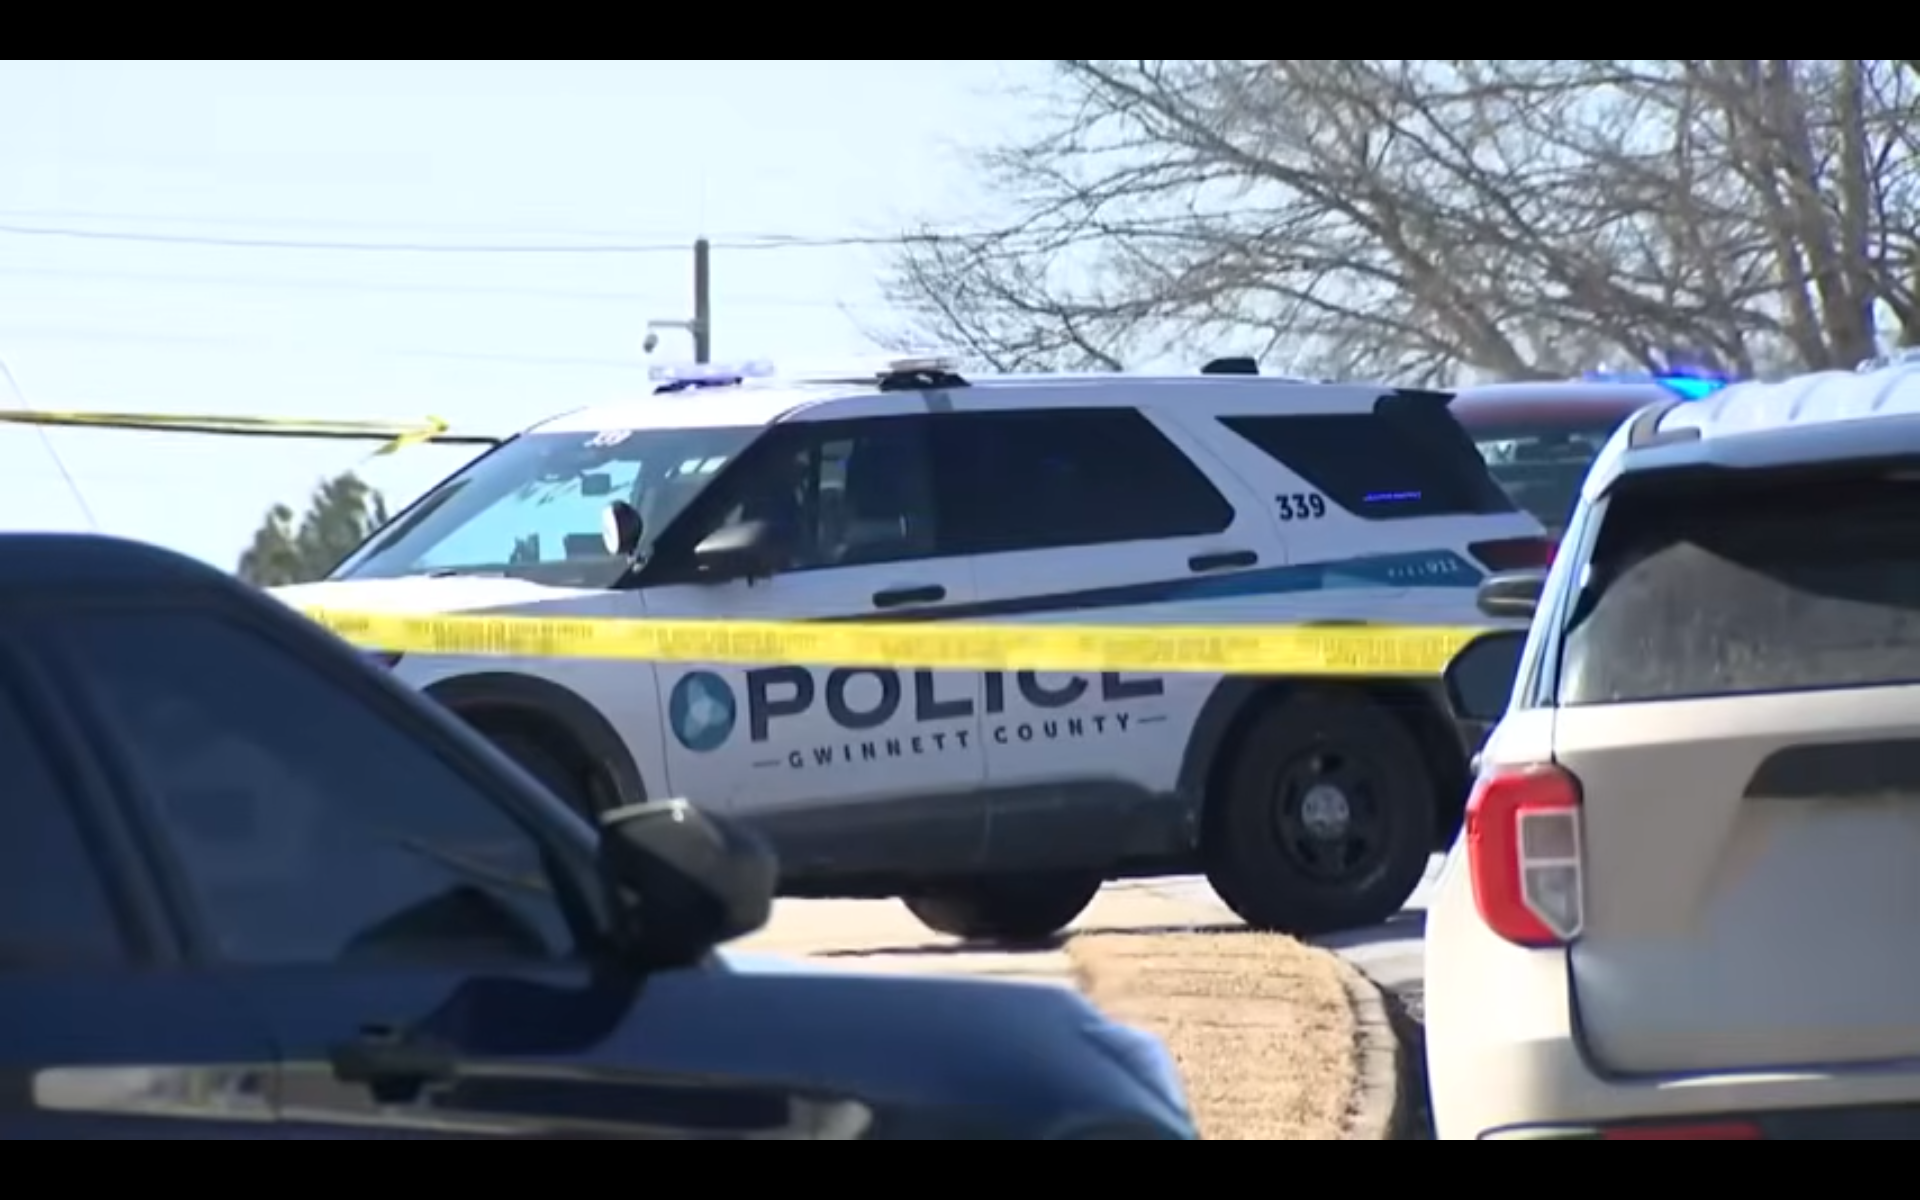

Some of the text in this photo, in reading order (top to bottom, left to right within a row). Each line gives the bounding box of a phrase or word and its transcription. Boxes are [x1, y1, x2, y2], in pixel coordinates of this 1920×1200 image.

[1275, 493, 1326, 521] 339
[788, 711, 1130, 769] GWINNETT COUNTY
